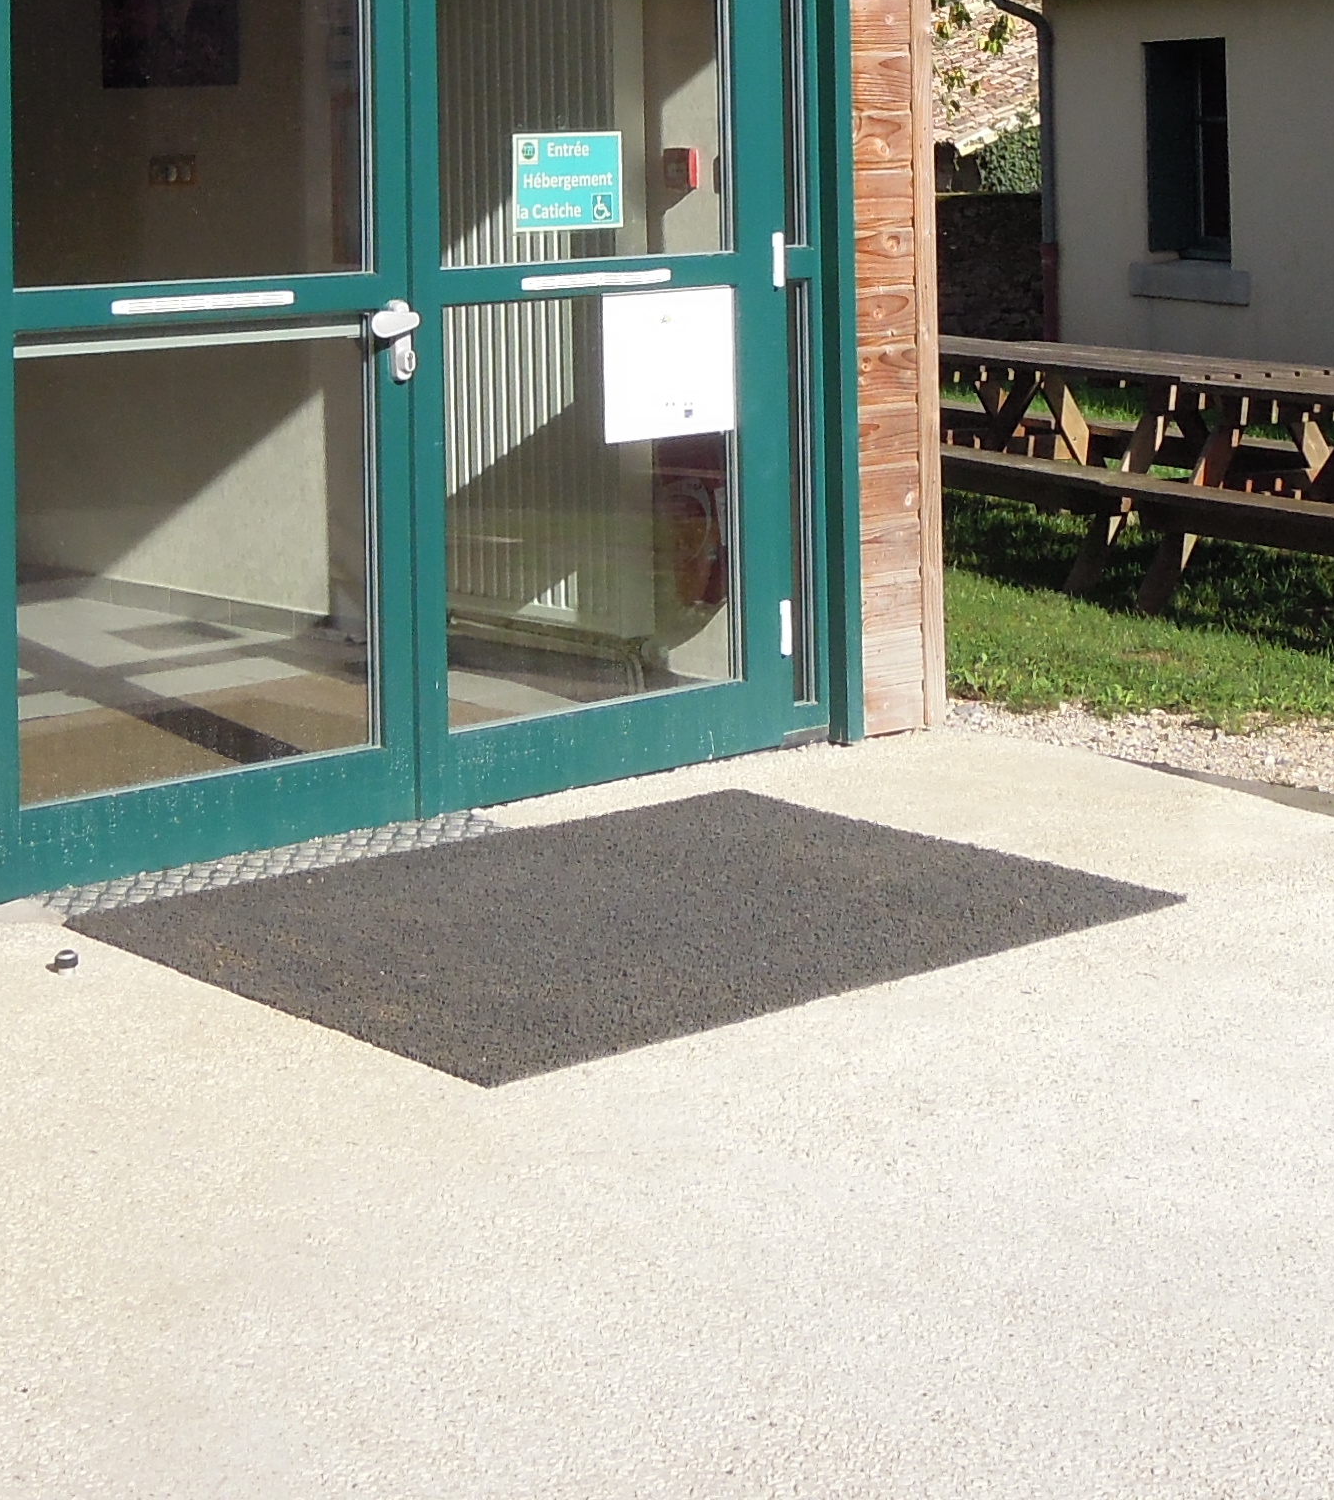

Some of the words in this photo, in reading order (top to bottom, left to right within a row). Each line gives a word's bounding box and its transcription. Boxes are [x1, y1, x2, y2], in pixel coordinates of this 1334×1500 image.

[547, 141, 590, 158] Entrée
[523, 172, 613, 192] Hébergement
[517, 204, 529, 220] la
[532, 202, 582, 219] Catiche
